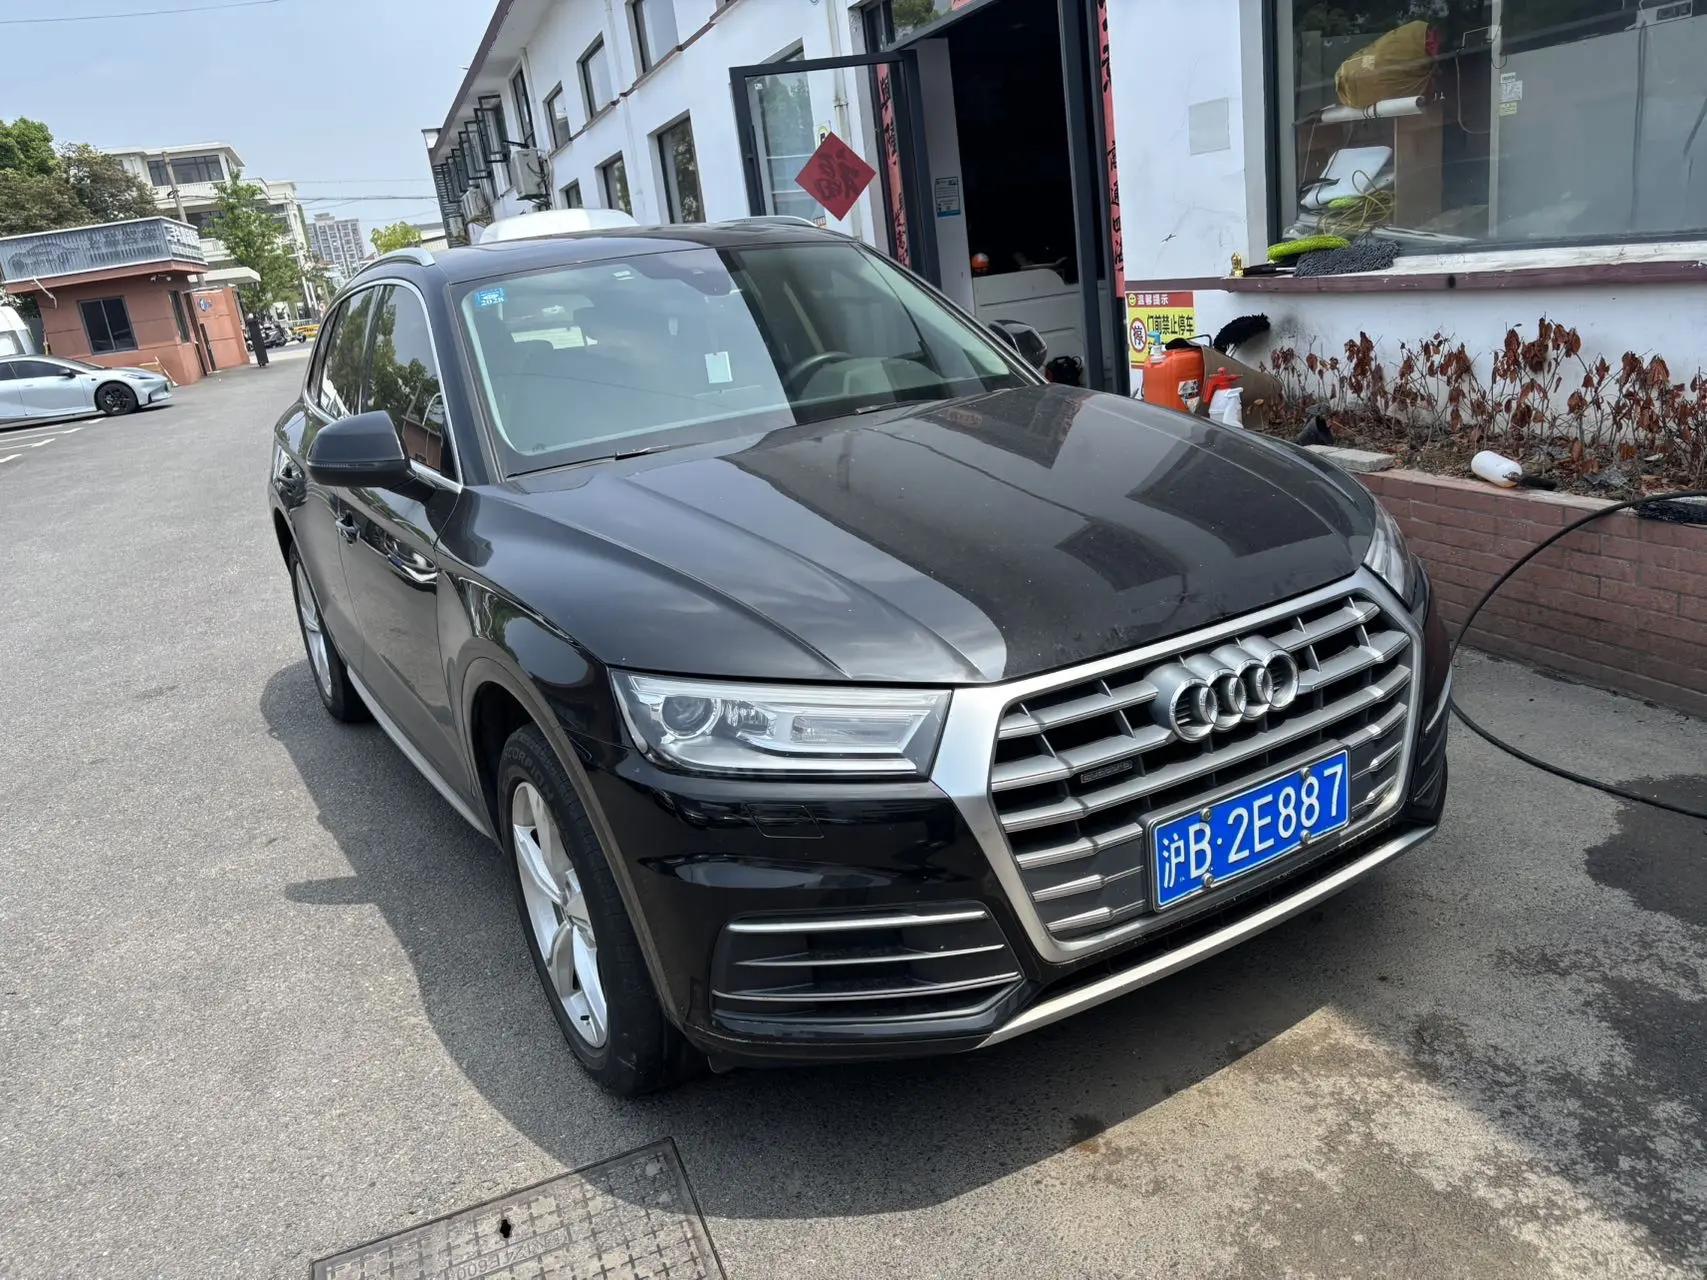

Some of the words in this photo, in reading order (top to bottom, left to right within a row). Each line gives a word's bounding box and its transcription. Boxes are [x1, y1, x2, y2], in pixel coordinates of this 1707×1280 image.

[1147, 314, 1194, 335] 门前禁止停车
